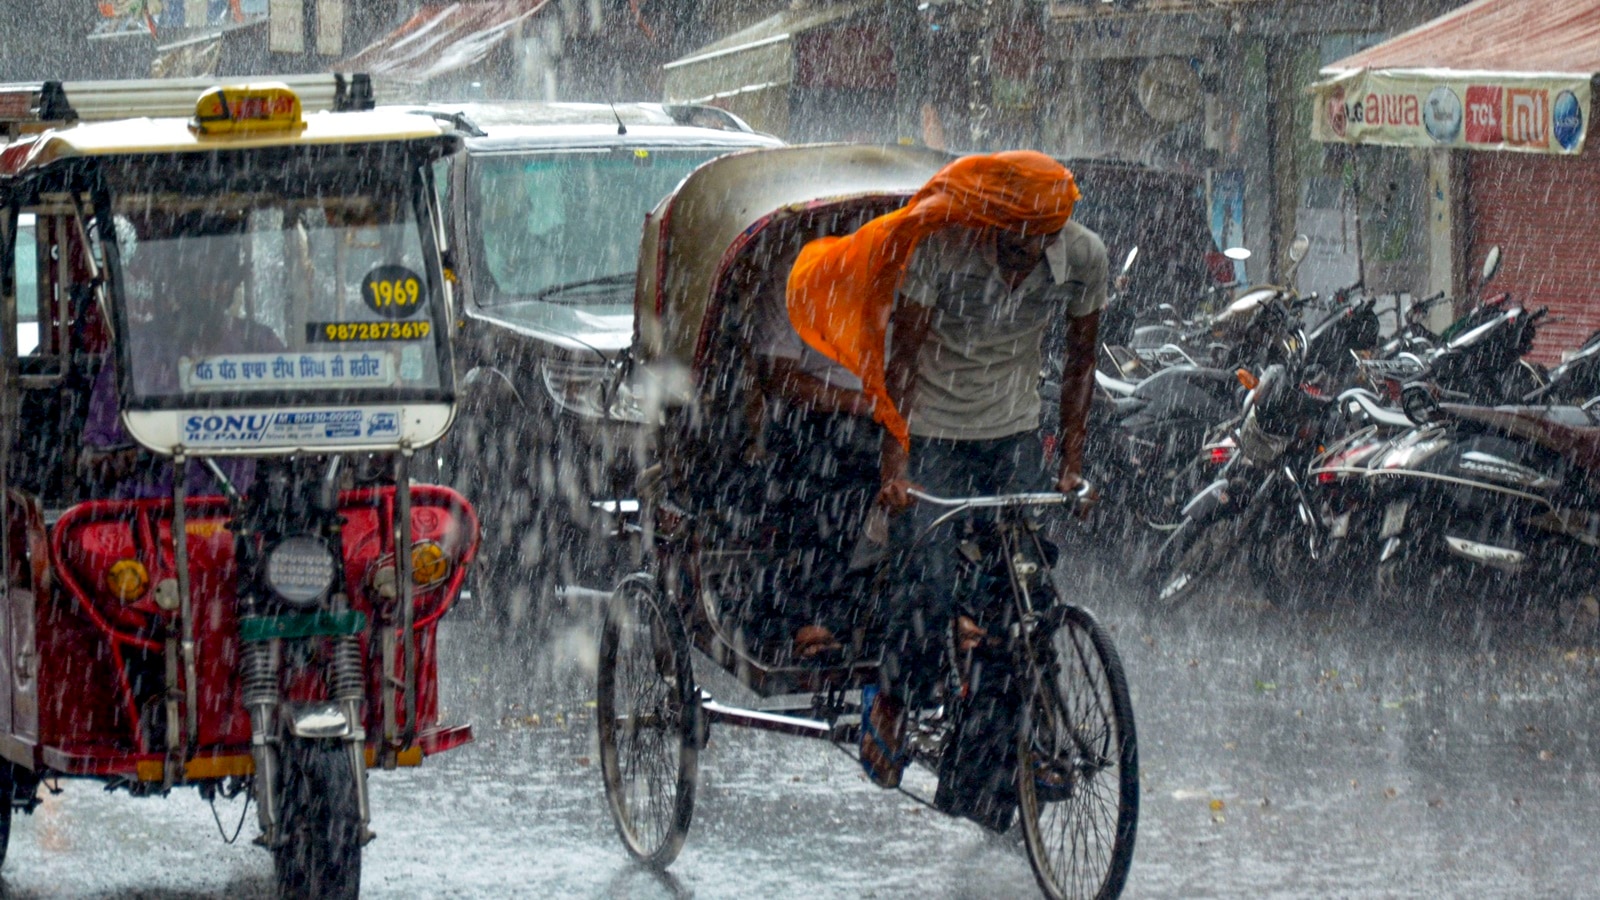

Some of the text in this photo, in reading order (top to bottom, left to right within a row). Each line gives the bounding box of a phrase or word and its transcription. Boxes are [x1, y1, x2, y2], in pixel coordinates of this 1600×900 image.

[1345, 101, 1364, 122] LG
[1470, 103, 1496, 126] TCL
[370, 278, 420, 307] 1969
[326, 321, 430, 340] 9872873619
[185, 413, 267, 433] SONU
[188, 432, 260, 441] REPAIR
